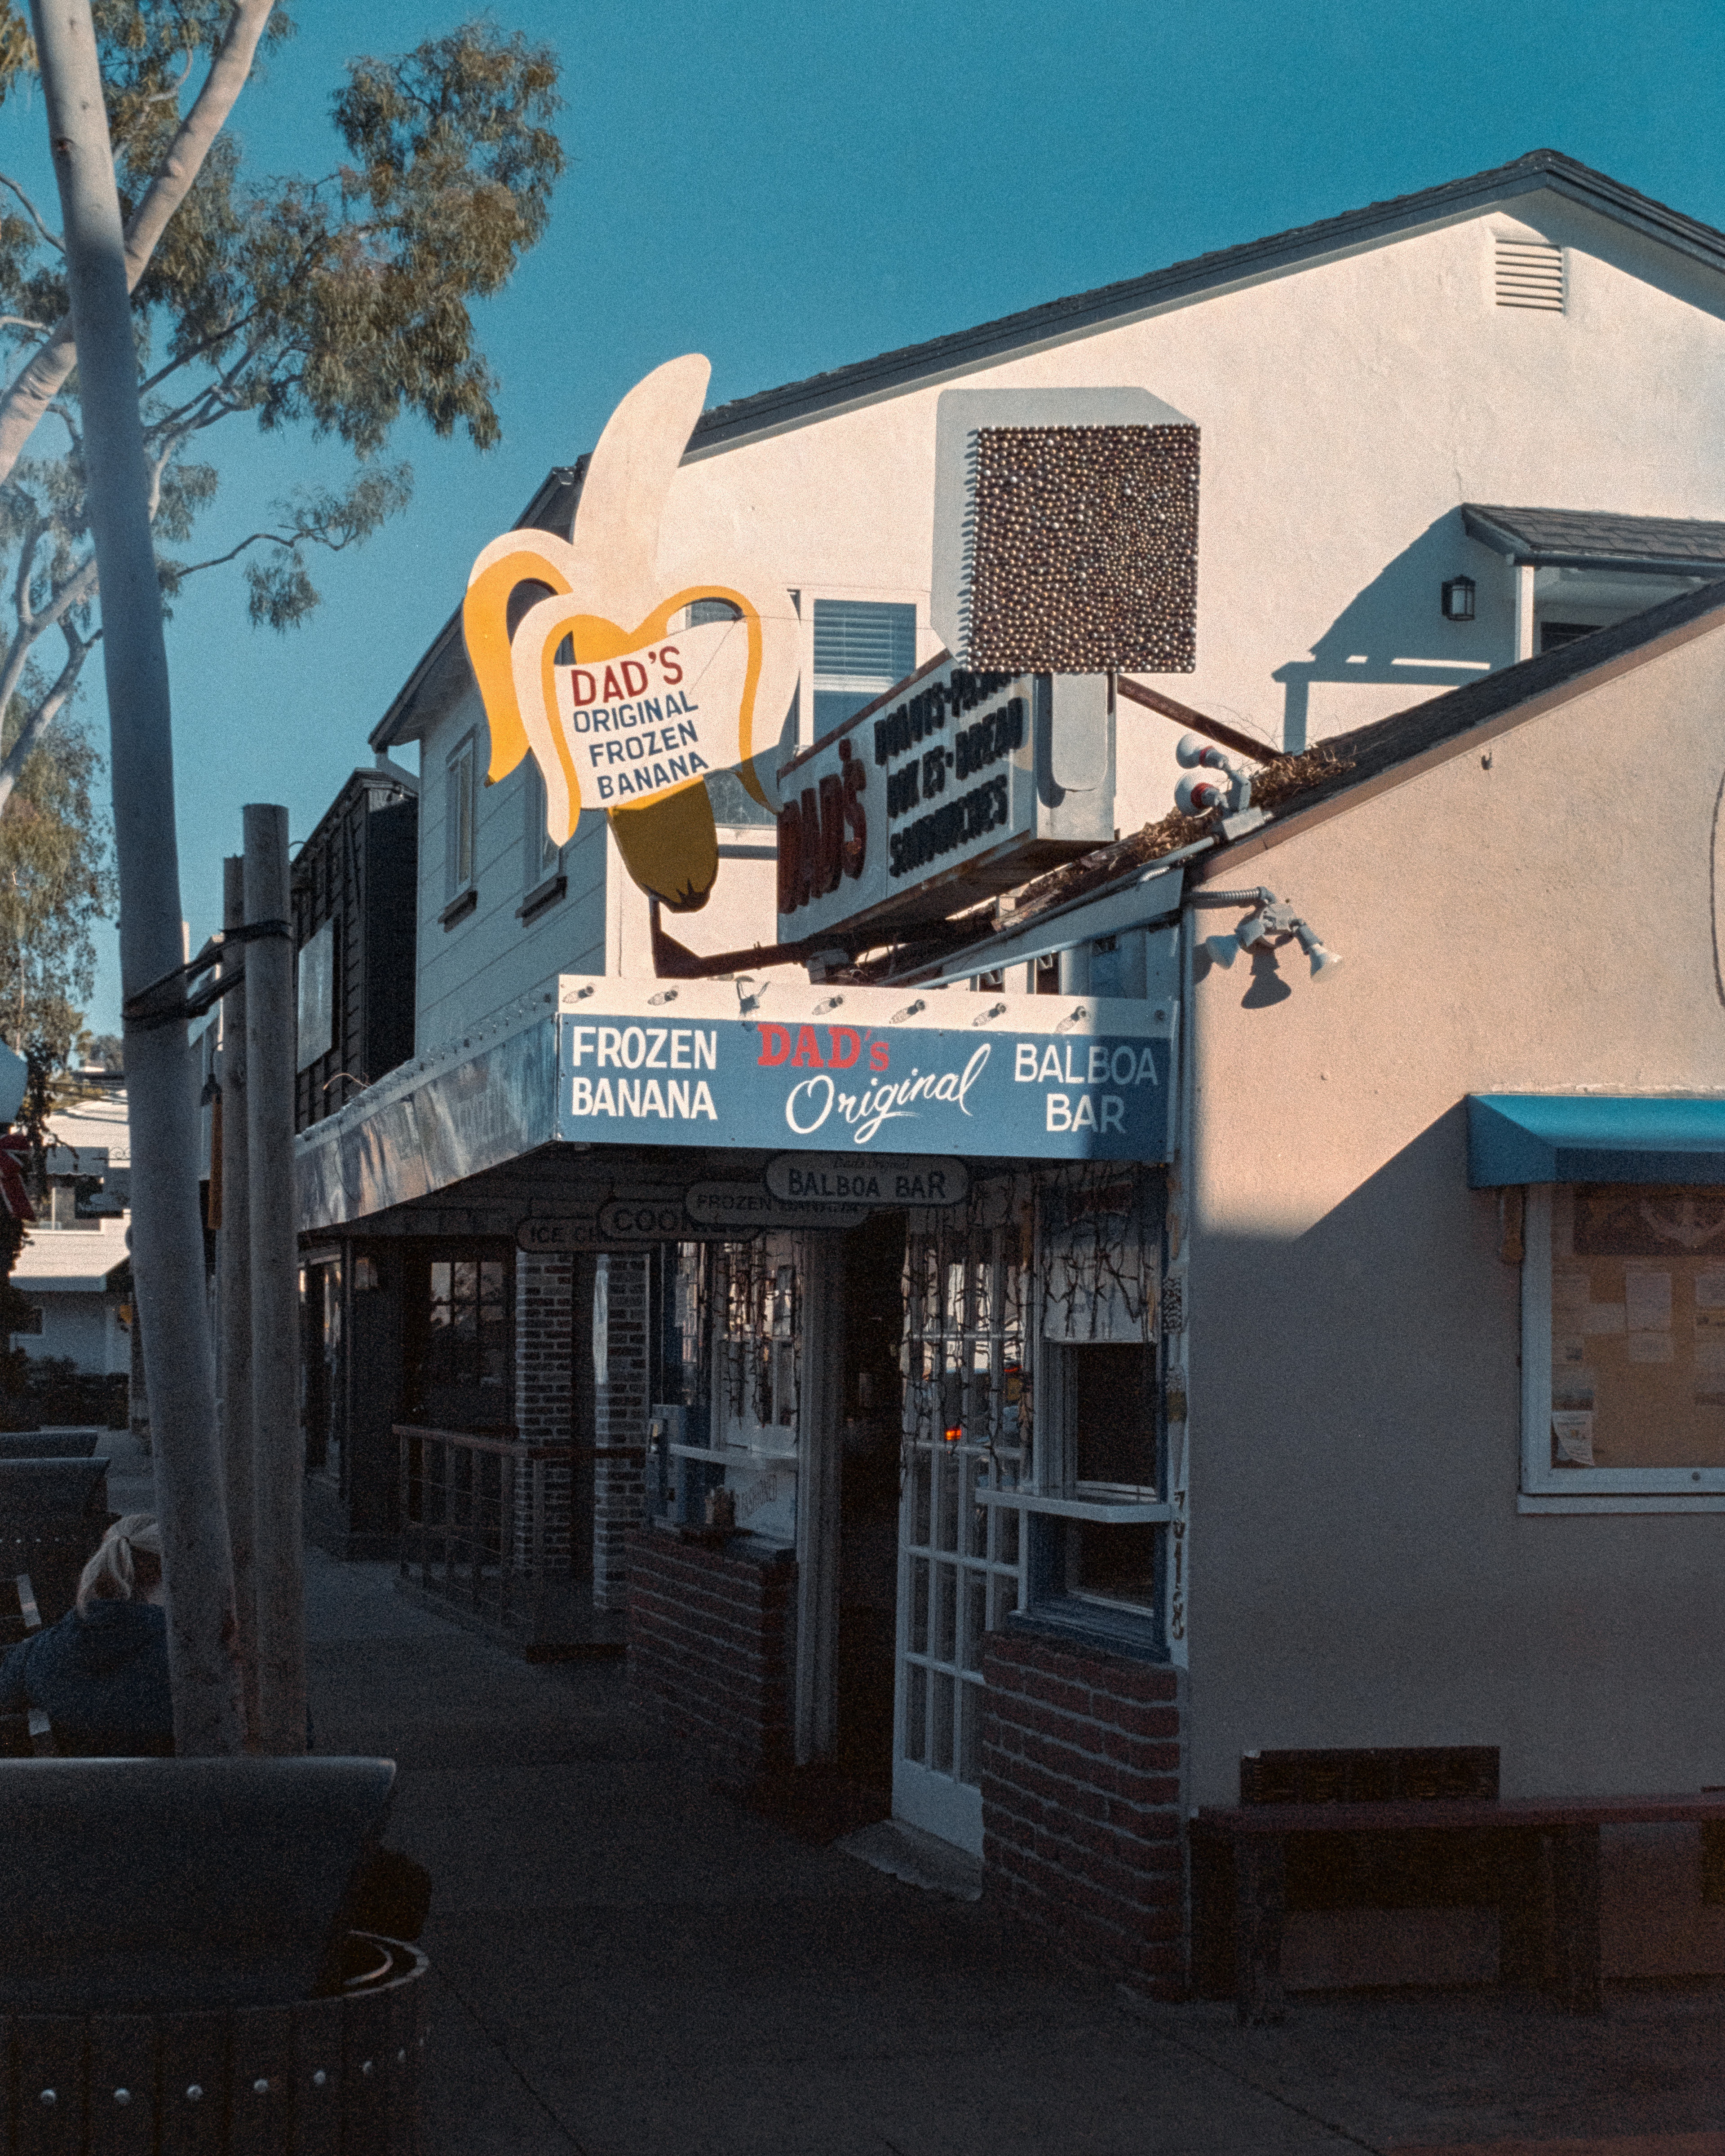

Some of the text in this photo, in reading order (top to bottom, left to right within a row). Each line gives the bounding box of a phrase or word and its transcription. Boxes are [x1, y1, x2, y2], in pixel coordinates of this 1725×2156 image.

[571, 645, 683, 707] DAD'S
[573, 690, 699, 733] ORIGINAL
[589, 720, 699, 768] FROZEN
[597, 751, 709, 800] BANANA
[573, 1026, 717, 1070] FROZEN
[1015, 1043, 1159, 1085] BALBOA
[572, 1077, 718, 1120] BANANA
[786, 1043, 991, 1144] Original
[1046, 1093, 1125, 1134] BAR
[697, 1194, 772, 1211] FROZEN
[789, 1169, 946, 1199] BALBOA BAR
